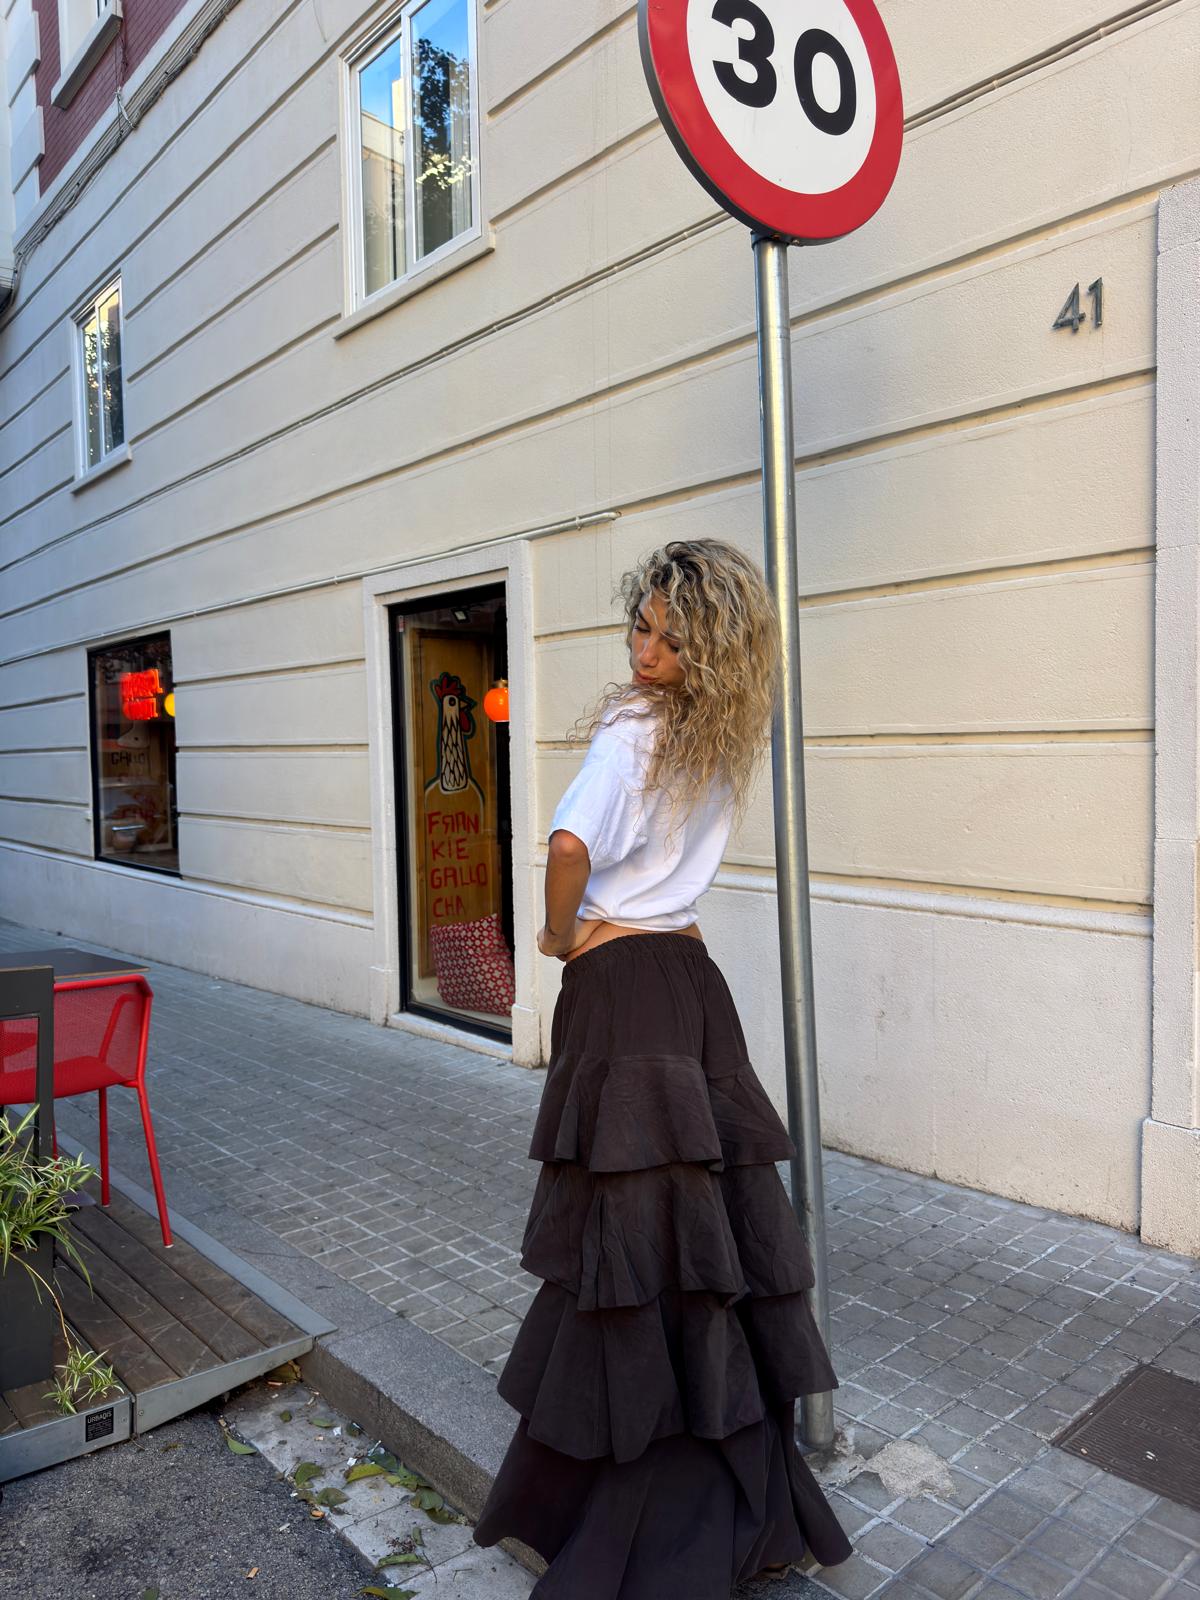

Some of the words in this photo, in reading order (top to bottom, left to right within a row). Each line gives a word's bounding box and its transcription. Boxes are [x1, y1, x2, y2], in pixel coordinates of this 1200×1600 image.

[711, 0, 857, 136] 30
[1052, 277, 1103, 332] 41
[427, 811, 479, 834] FRAN
[431, 838, 469, 860] KIE
[430, 863, 488, 889] GALLO
[432, 895, 466, 917] CHA
